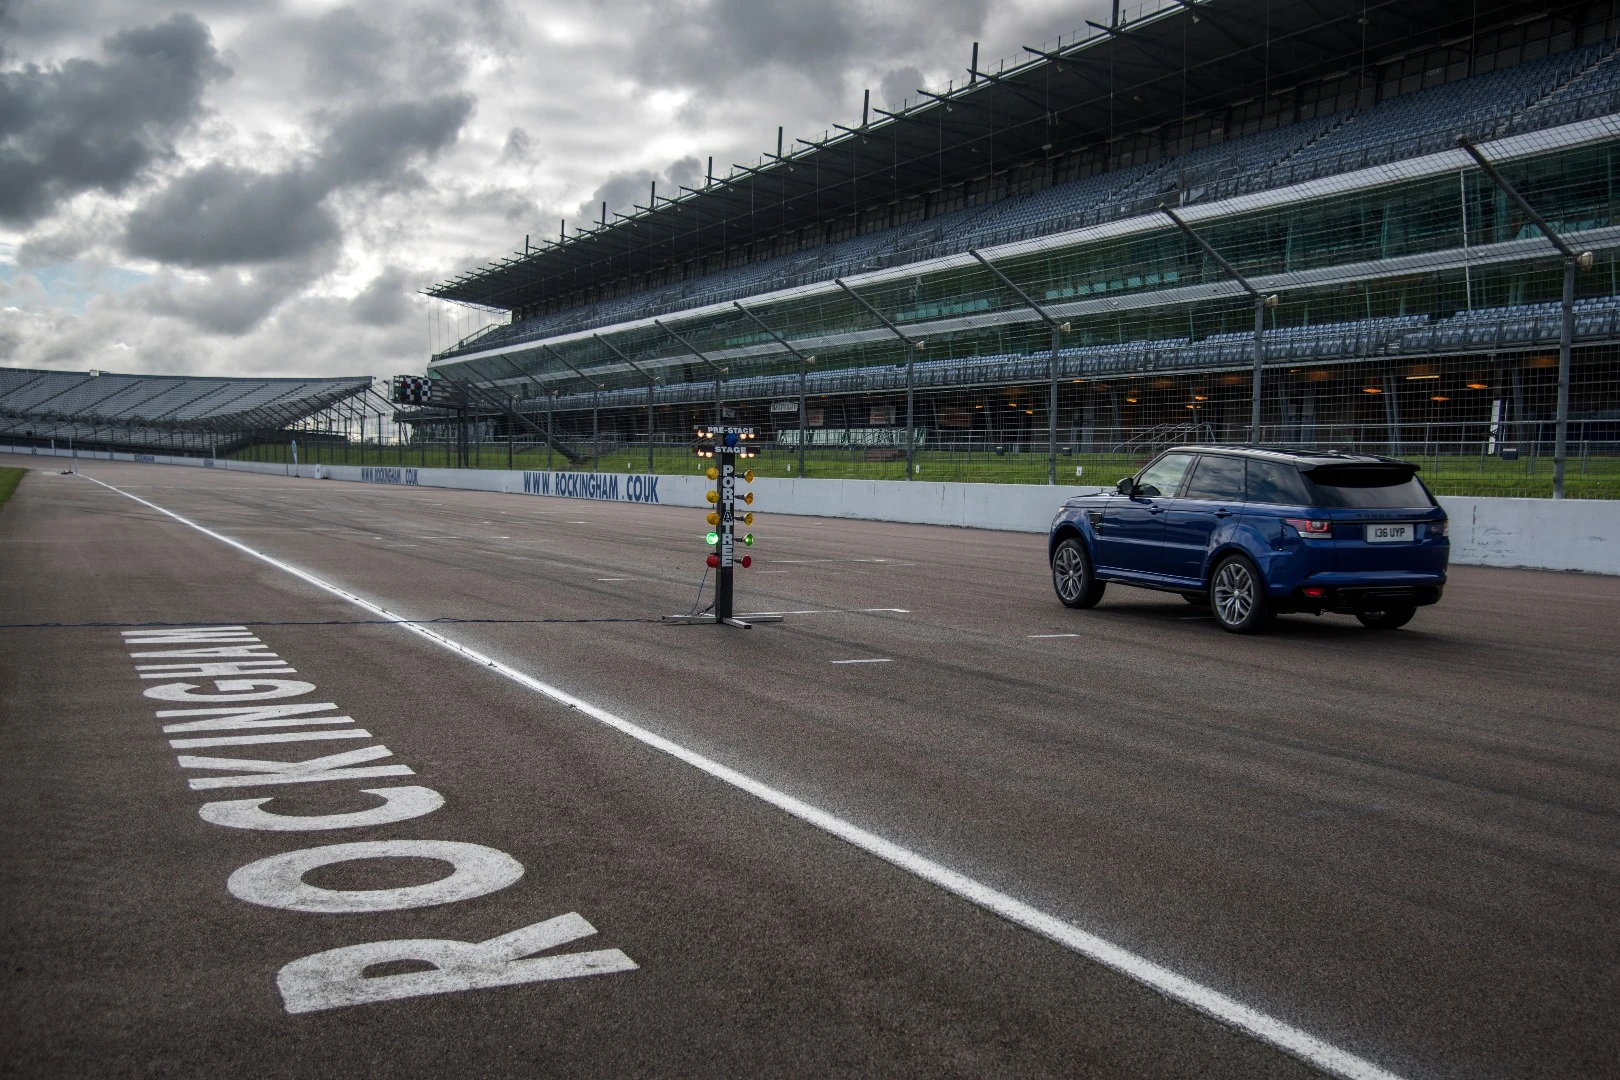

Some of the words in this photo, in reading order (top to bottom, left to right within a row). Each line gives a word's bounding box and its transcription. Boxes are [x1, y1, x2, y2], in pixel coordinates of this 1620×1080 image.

[708, 426, 754, 434] PRE-STAGE
[555, 473, 619, 500] ROCKINGHAM
[1375, 528, 1388, 538] 136
[1389, 527, 1405, 537] UYP
[121, 626, 640, 1015] ROCKINGHAM
